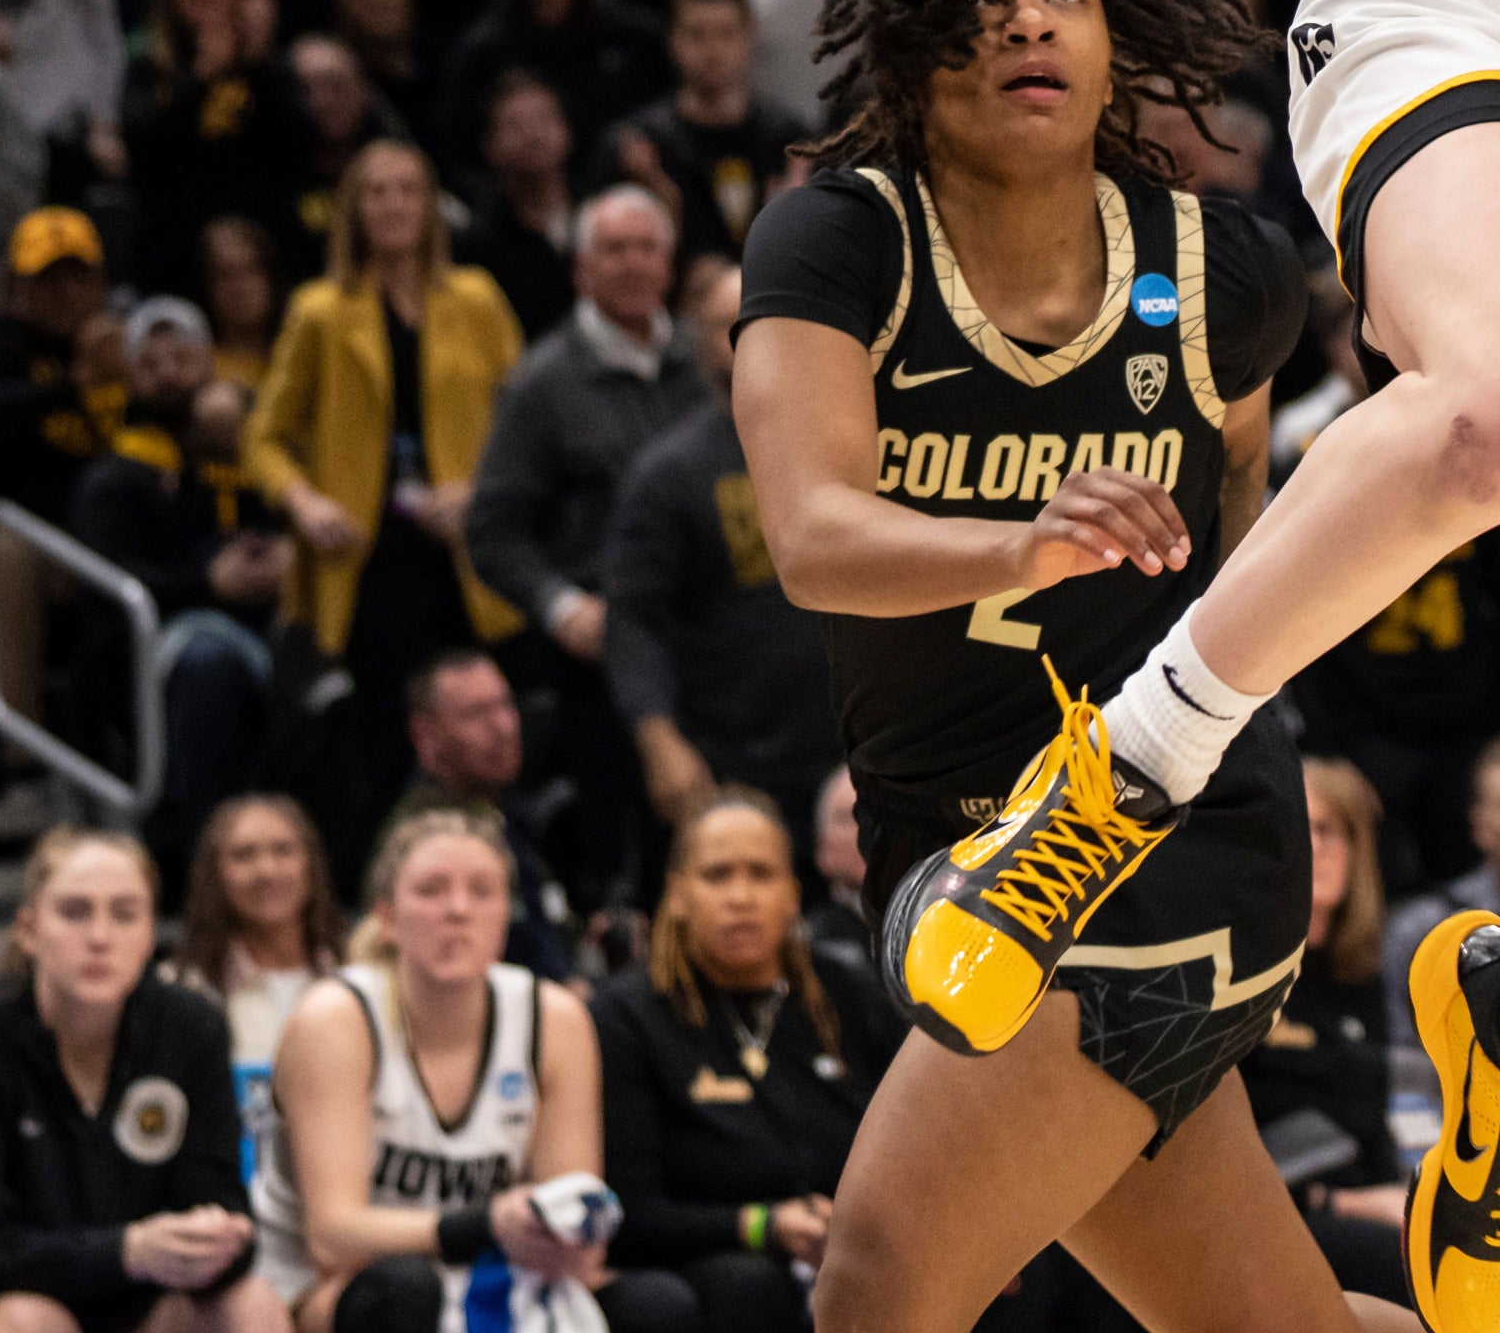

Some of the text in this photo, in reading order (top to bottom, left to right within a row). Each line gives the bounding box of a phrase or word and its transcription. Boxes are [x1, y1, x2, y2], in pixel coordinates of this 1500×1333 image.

[1138, 298, 1179, 313] NCAA
[1135, 378, 1156, 400] 12
[875, 427, 1185, 501] COLORADO
